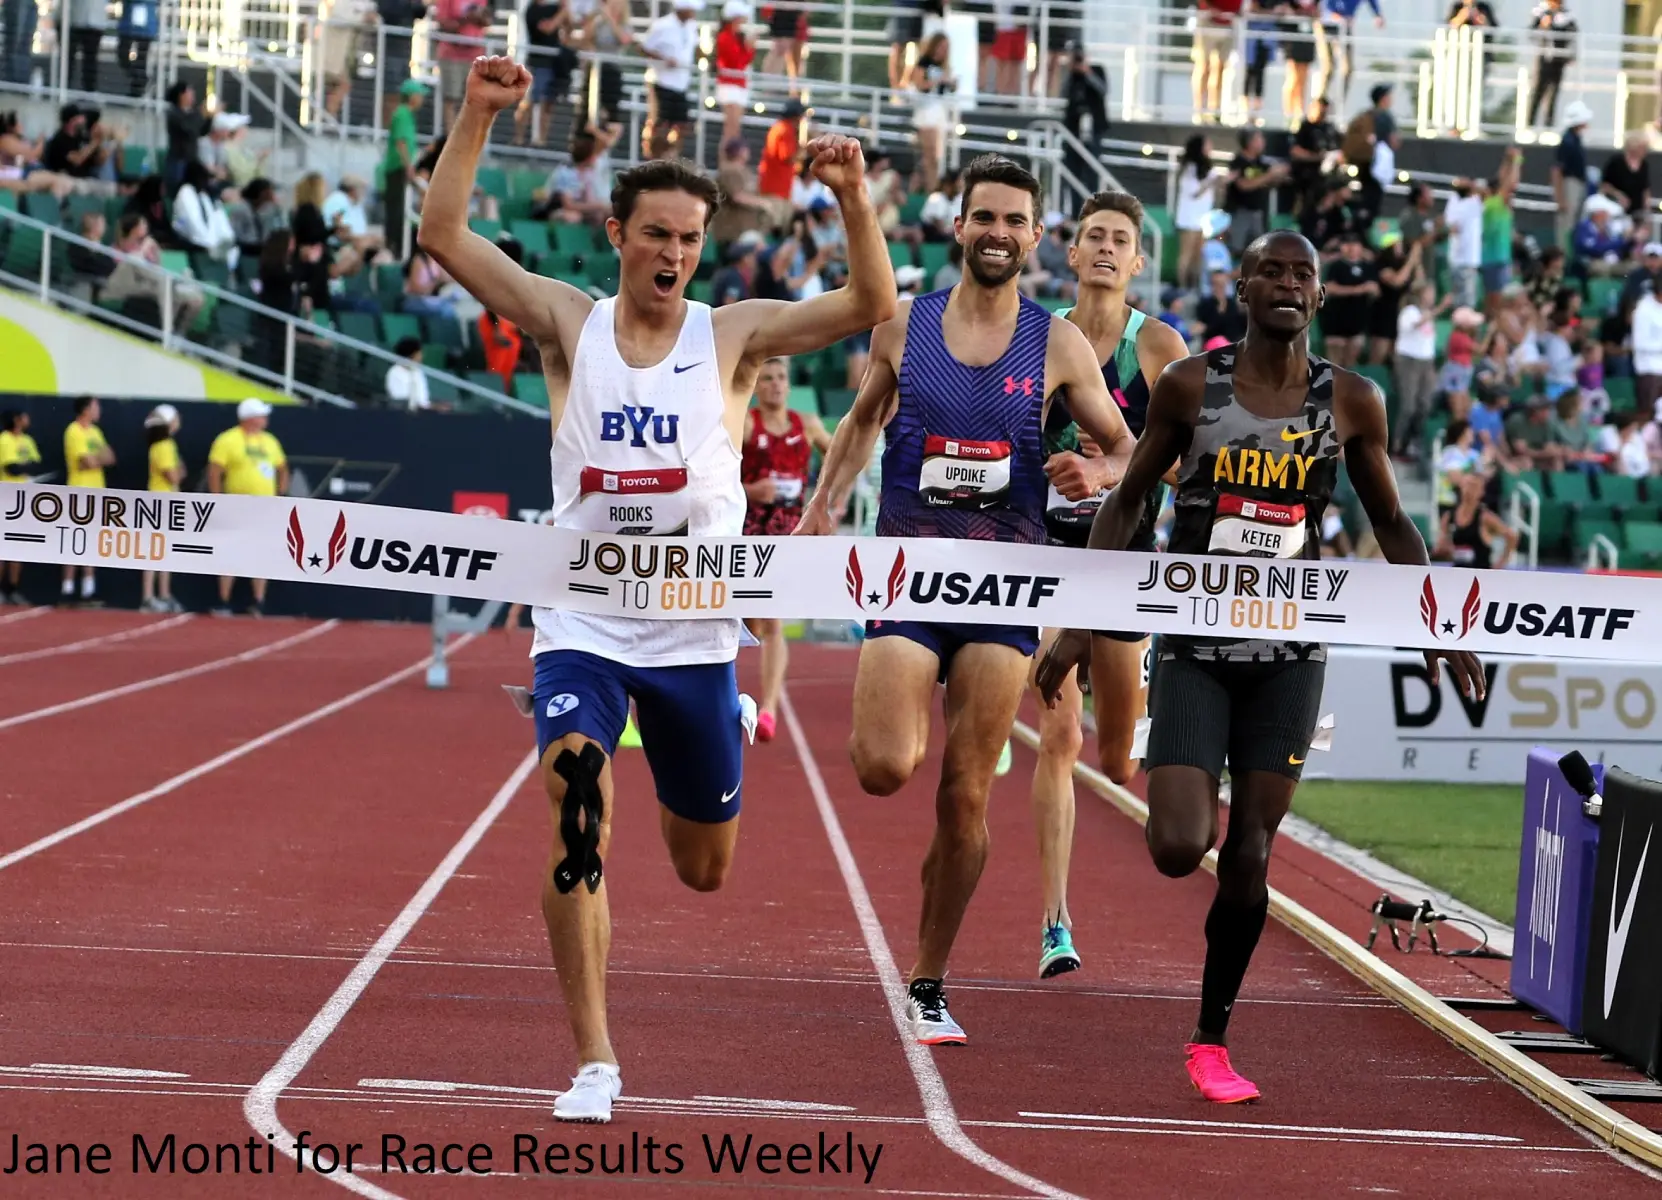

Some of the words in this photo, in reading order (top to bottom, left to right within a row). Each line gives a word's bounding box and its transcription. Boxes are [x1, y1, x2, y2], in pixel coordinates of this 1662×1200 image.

[600, 404, 679, 448] BYU
[961, 446, 991, 455] TOYOTA
[621, 478, 660, 487] TOYOTA
[945, 466, 987, 483] UPDIKE
[1214, 447, 1315, 490] ARMY
[5, 490, 215, 533] JOURNEY
[609, 506, 653, 522] ROOKS
[1258, 508, 1291, 520] TOYOTA
[56, 526, 87, 556] TO
[97, 529, 166, 561] GOLD
[1241, 529, 1282, 549] KETER
[349, 537, 498, 581] USATF
[569, 539, 776, 579] JOURNEY
[618, 579, 649, 609] TO
[660, 581, 727, 610] GOLD
[909, 571, 1060, 608] USATF
[1138, 560, 1349, 601] JOURNEY
[1188, 596, 1219, 626] TO
[1230, 599, 1298, 631] GOLD
[1483, 601, 1636, 641] USATF
